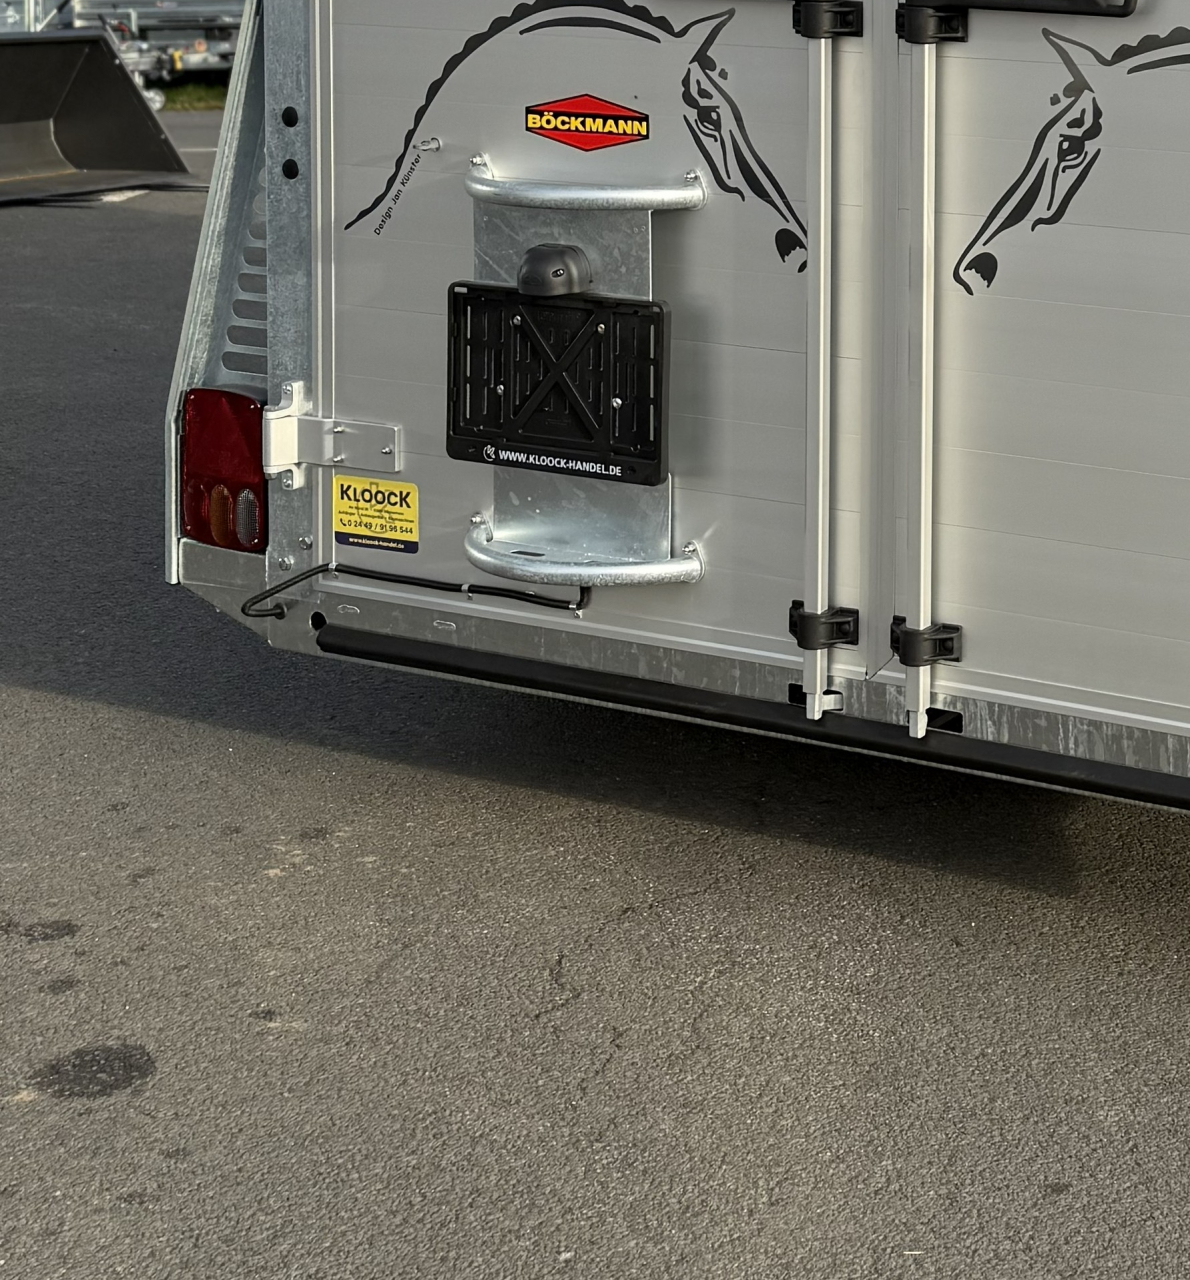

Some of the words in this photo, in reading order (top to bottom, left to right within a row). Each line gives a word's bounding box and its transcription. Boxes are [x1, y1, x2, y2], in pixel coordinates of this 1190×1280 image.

[527, 111, 647, 136] BÖCKMANN
[373, 206, 394, 236] Design
[391, 189, 403, 205] Jan
[399, 153, 422, 188] Künster
[498, 449, 622, 476] WWW.KLOOCK-HANDEL.DE
[340, 483, 412, 509] KLOOCK
[399, 526, 413, 535] 544
